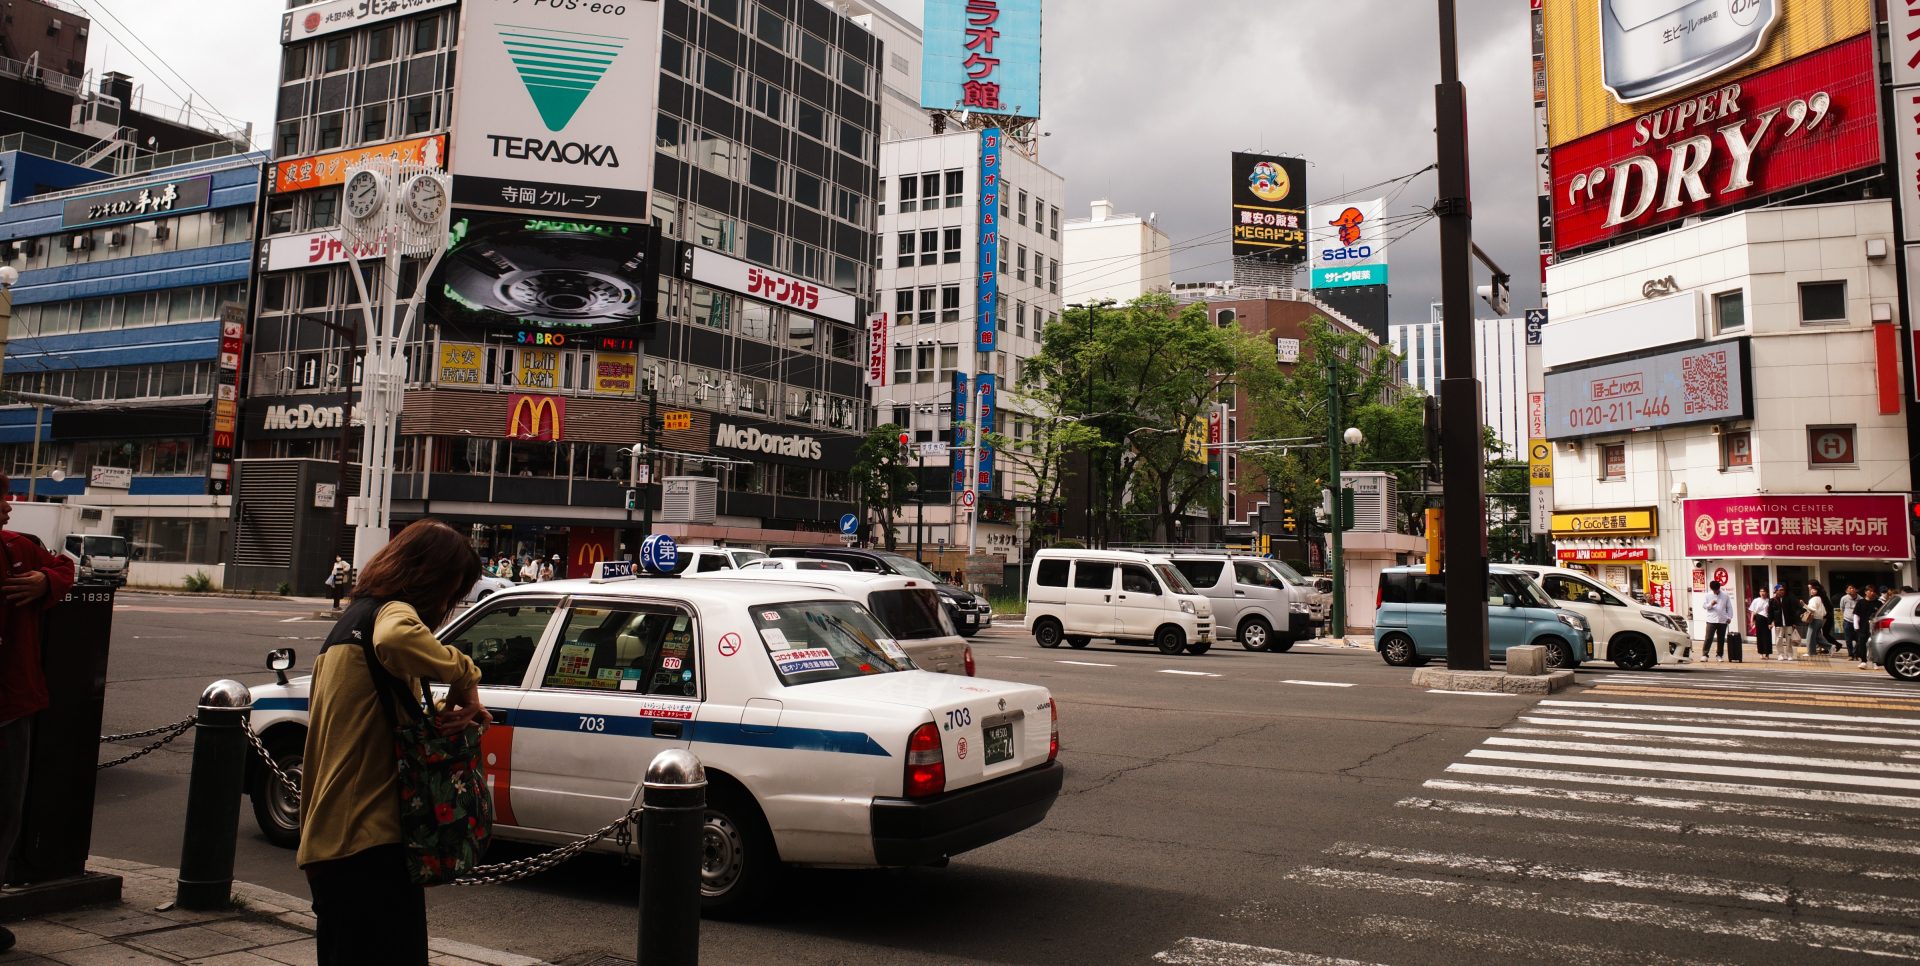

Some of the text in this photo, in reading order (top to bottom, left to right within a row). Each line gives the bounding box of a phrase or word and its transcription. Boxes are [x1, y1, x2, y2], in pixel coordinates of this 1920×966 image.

[1632, 84, 1742, 148] SUPER
[487, 134, 620, 168] TERAOKA
[1241, 210, 1299, 229] 驚安の殿堂
[1235, 225, 1305, 243] MEGAドンキ
[1324, 270, 1371, 283] サトウ製薬
[748, 267, 819, 310] ジャンカラ
[517, 331, 565, 346] SABRO
[870, 318, 884, 381] ジャンカラ
[1593, 378, 1641, 398] ほっとハウス
[1532, 395, 1542, 435] ほっとハウス
[1569, 396, 1671, 428] 0120-211-446
[1726, 504, 1834, 513] INFORMATION CENTER
[1583, 515, 1627, 529] CoCo壱番屋
[1717, 517, 1888, 537] すすきの無料案内所
[1713, 543, 1725, 551] find
[1726, 543, 1738, 551] the
[1738, 542, 1754, 553] right
[1754, 542, 1773, 551] bars
[1774, 542, 1794, 551] and
[1796, 542, 1850, 552] restaurants
[1851, 543, 1865, 552] for
[1867, 544, 1890, 553] you.
[603, 562, 631, 577] カードOK
[664, 658, 681, 668] 670
[774, 649, 830, 662] コロナ感染予防対策
[643, 702, 692, 711] いらっしゃいませ
[579, 716, 605, 732] 703
[946, 707, 972, 730] 703
